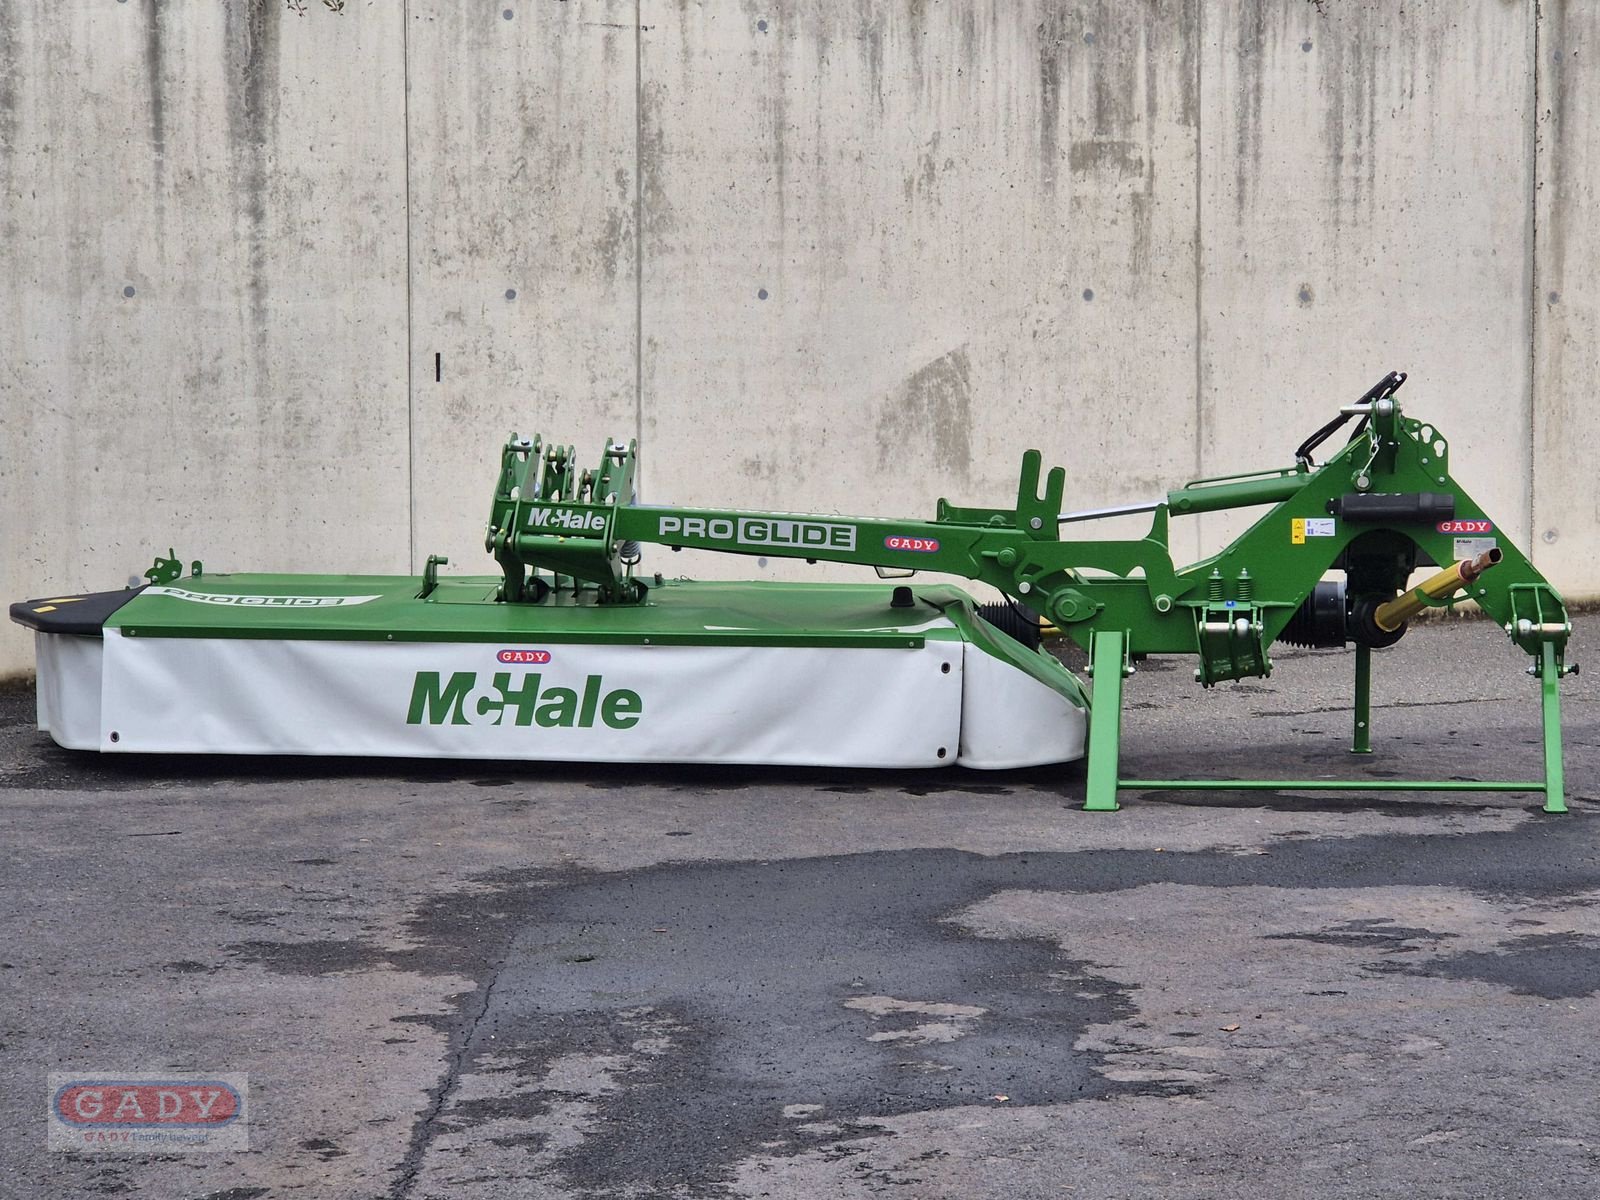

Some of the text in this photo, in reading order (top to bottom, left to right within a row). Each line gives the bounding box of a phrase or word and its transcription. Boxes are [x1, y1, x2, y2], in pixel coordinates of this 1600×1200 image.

[527, 507, 606, 531] McHale
[1441, 522, 1488, 531] GADY
[890, 538, 935, 551] GADY
[502, 652, 546, 662] GADY
[406, 671, 643, 730] McHale
